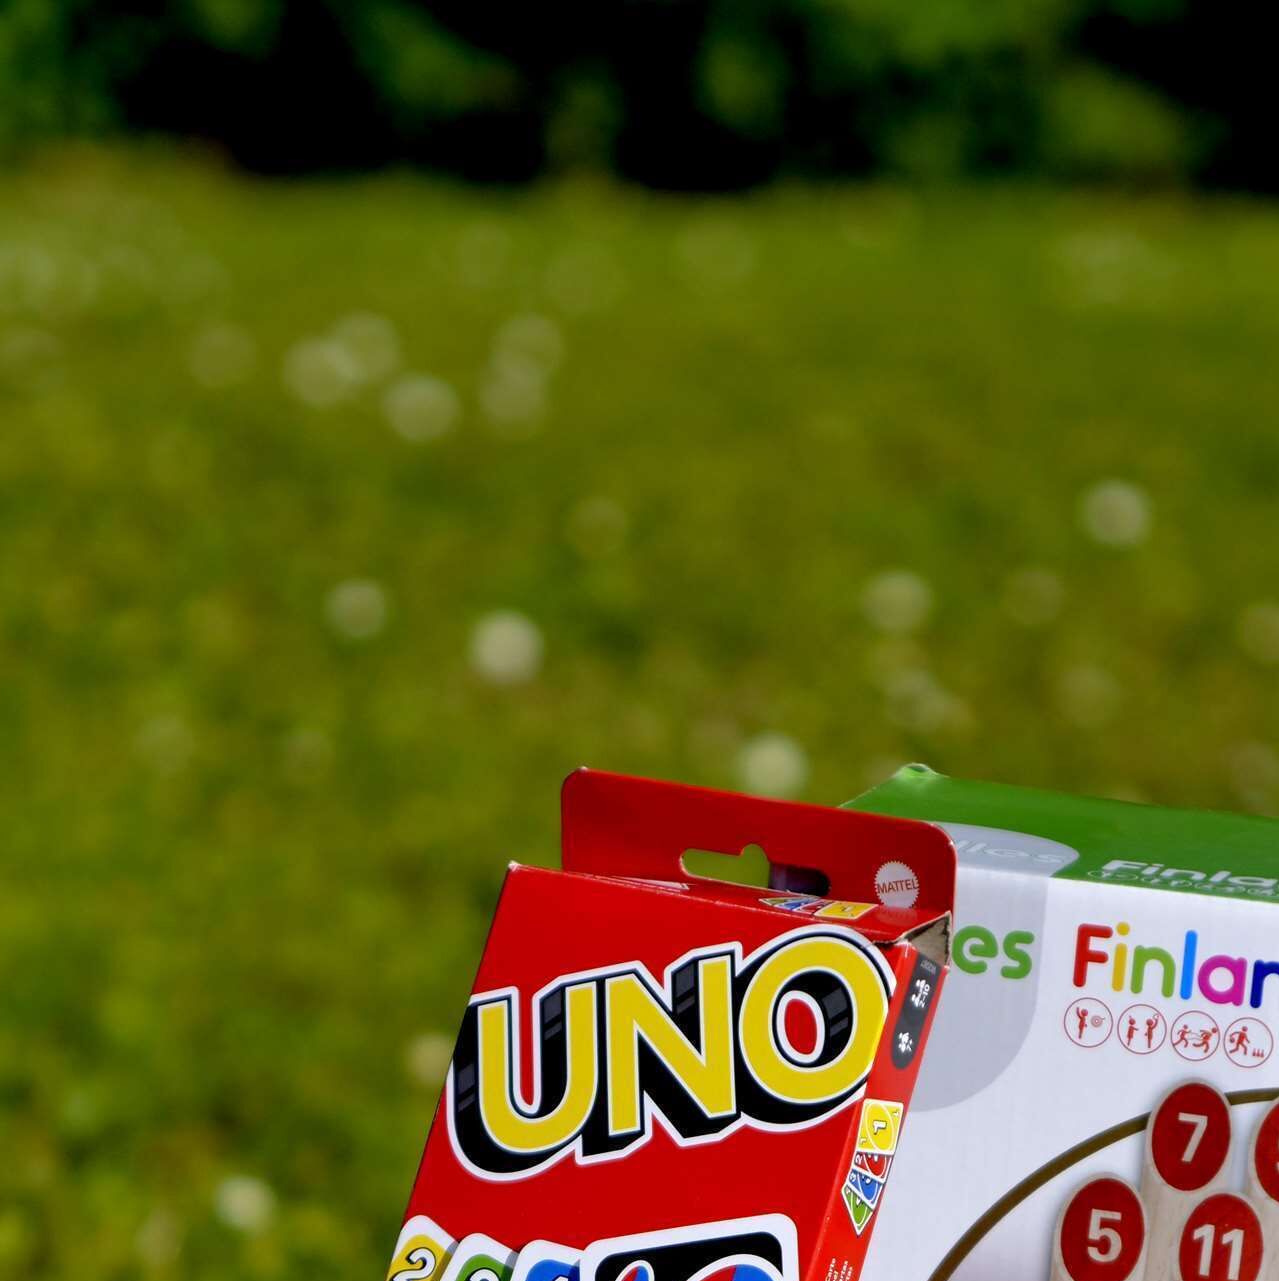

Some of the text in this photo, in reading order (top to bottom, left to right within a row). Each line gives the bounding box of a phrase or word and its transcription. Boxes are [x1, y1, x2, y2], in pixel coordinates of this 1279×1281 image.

[877, 878, 919, 895] MATTEL
[455, 930, 894, 1174] UNO
[1176, 1112, 1210, 1163] 7
[1085, 1208, 1123, 1264] 5
[1193, 1223, 1246, 1281] 11
